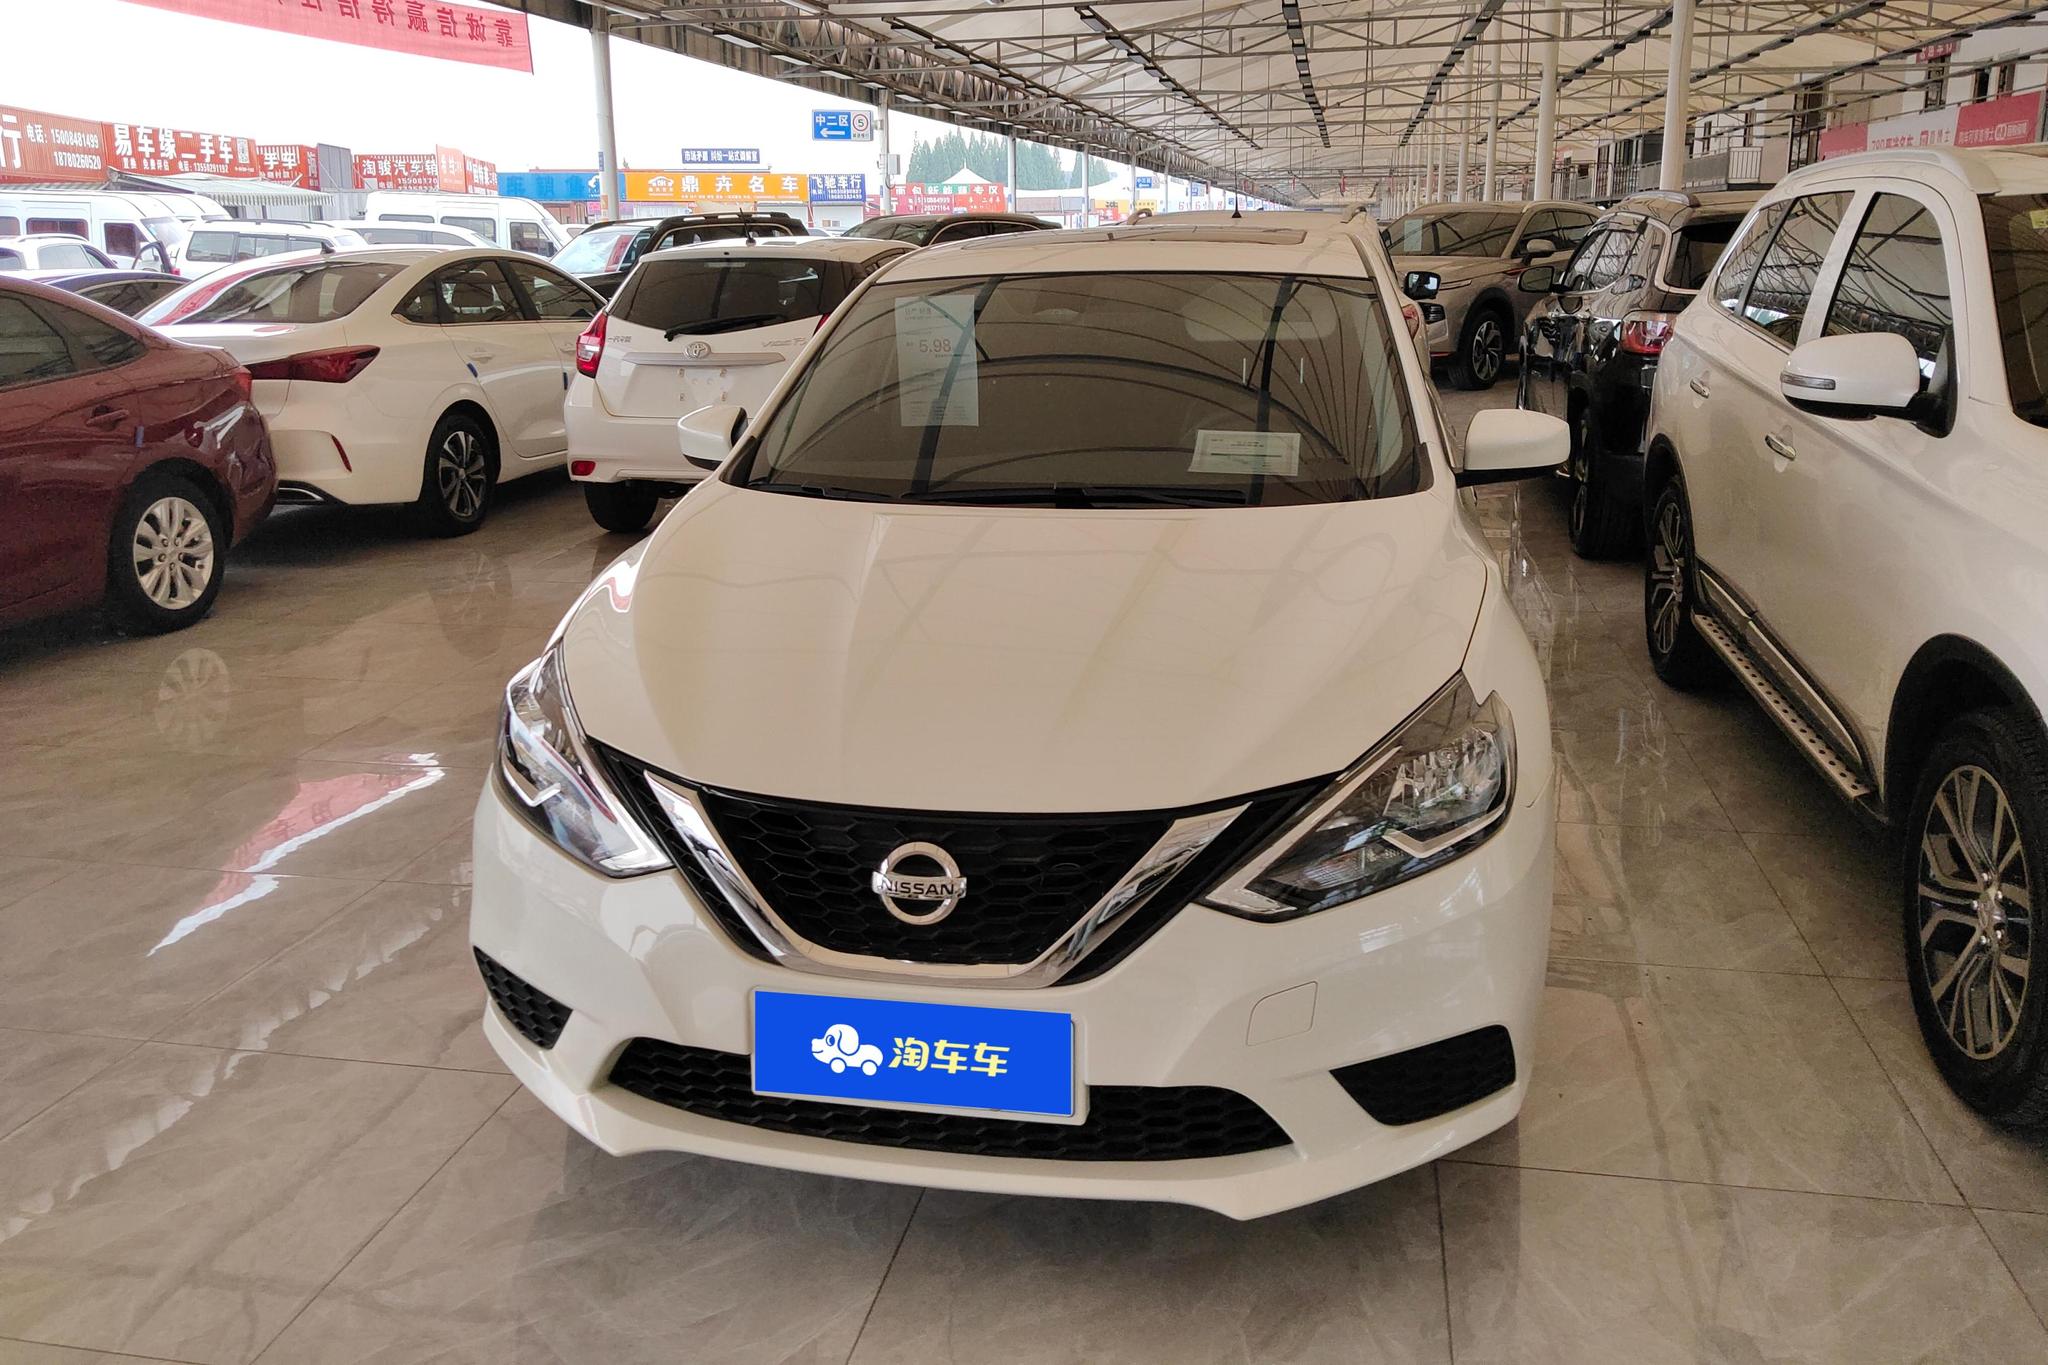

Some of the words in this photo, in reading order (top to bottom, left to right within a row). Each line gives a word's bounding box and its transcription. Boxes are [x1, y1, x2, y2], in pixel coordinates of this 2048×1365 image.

[815, 114, 849, 127] 中二区
[114, 123, 234, 164] 易车缘二手车
[681, 175, 800, 193] 鼎卉名车
[811, 174, 862, 189] 飞驰车行
[919, 338, 952, 353] 5.98
[880, 879, 954, 896] NISSAN
